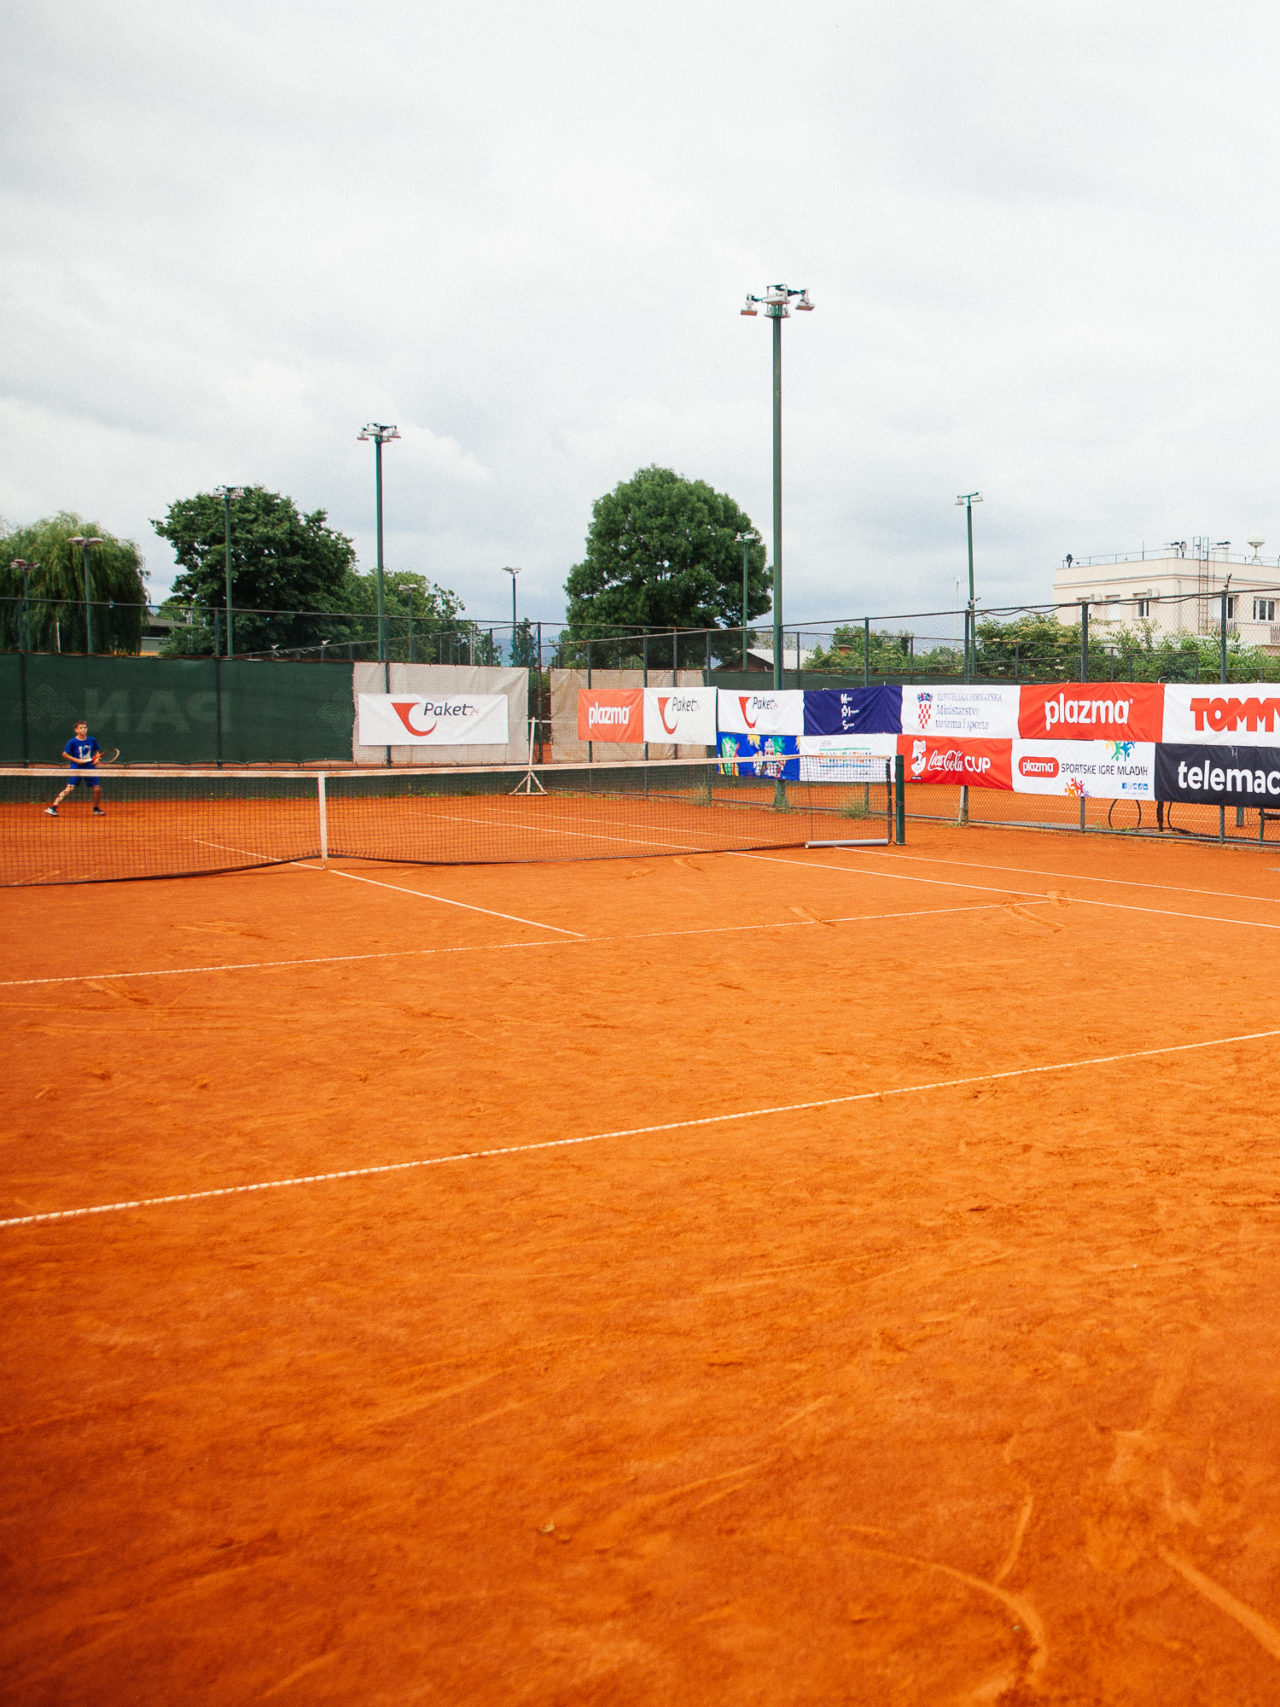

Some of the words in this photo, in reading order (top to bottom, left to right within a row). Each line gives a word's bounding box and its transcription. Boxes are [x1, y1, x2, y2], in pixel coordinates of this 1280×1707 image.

[424, 702, 473, 716] Paket
[589, 701, 630, 728] plazma
[1044, 693, 1129, 731] plazma
[964, 756, 991, 773] CUP
[1022, 760, 1054, 774] plazma
[1061, 763, 1096, 775] SPORTSKE
[1098, 765, 1115, 775] IGRE
[1117, 766, 1148, 776] MLADIH
